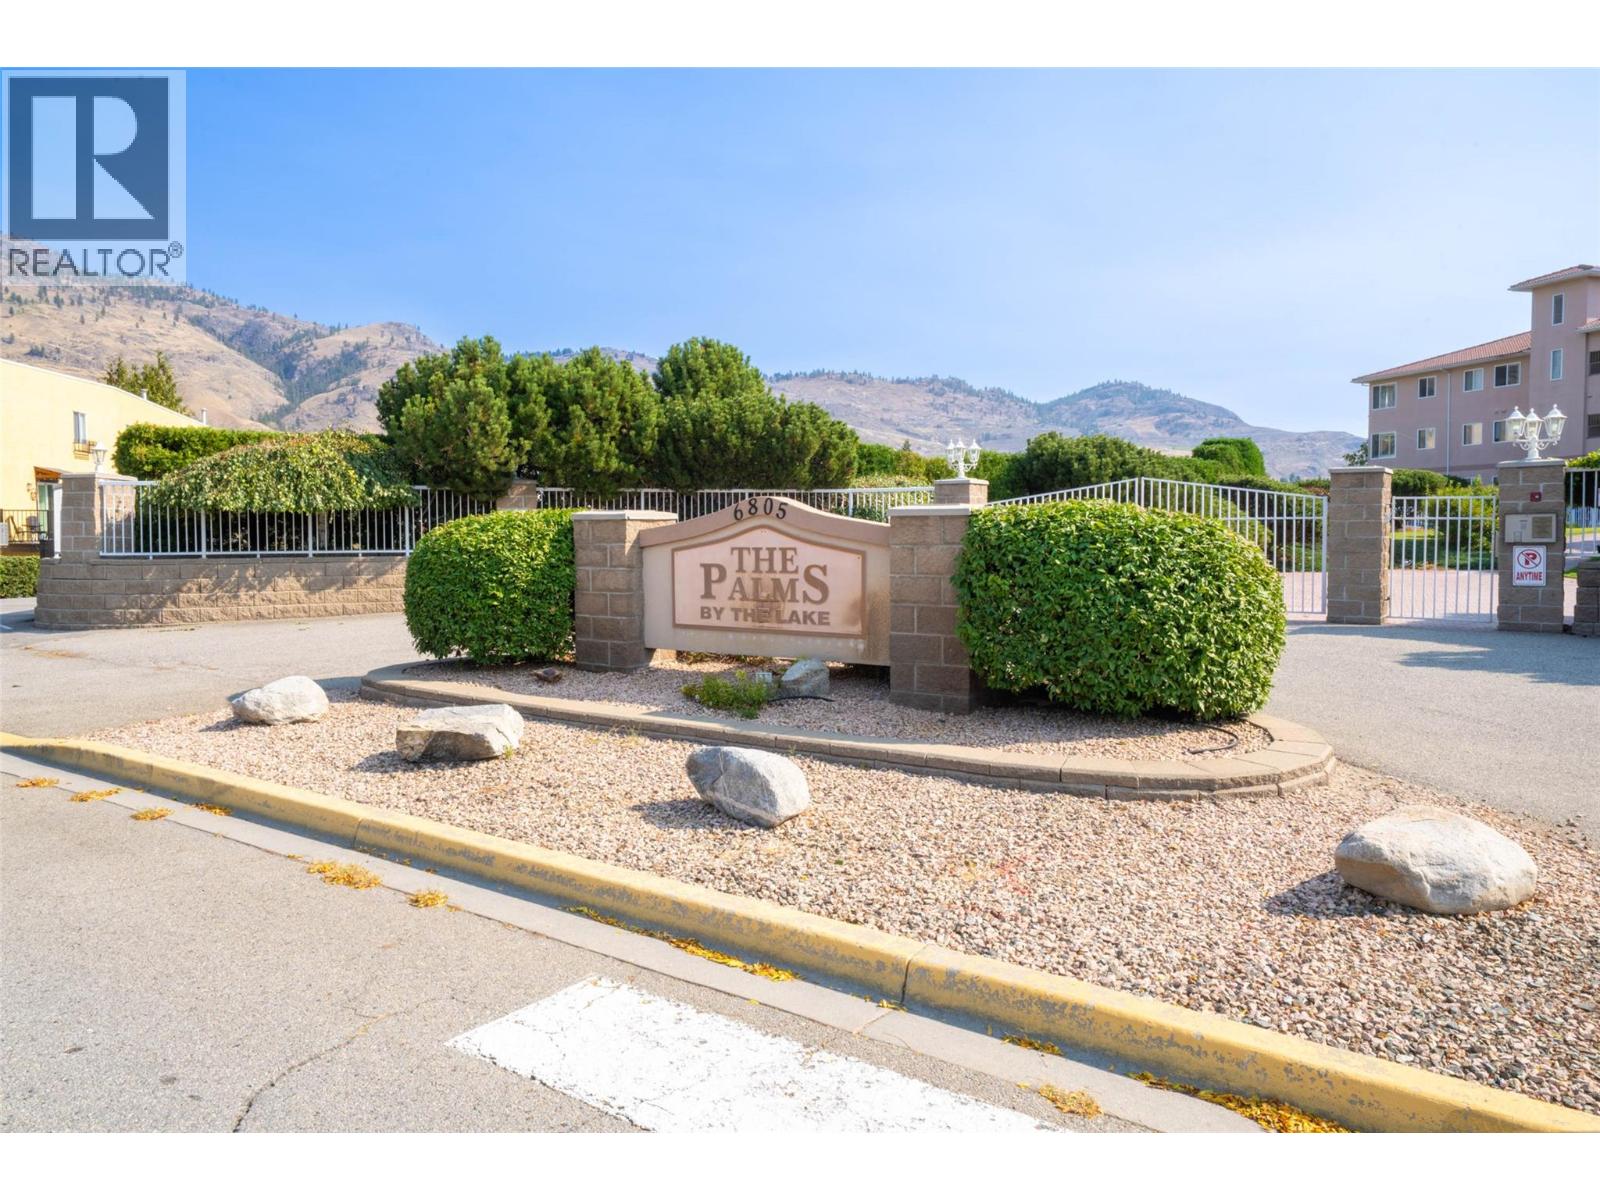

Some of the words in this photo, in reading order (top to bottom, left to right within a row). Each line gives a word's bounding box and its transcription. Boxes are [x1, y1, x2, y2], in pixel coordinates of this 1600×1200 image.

[733, 497, 789, 521] 6805
[730, 547, 799, 574] THE
[700, 563, 830, 605] PALMS
[1516, 571, 1543, 581] ANYTIME
[700, 607, 725, 621] BY
[730, 607, 772, 624] THE
[775, 609, 831, 626] LAKE
